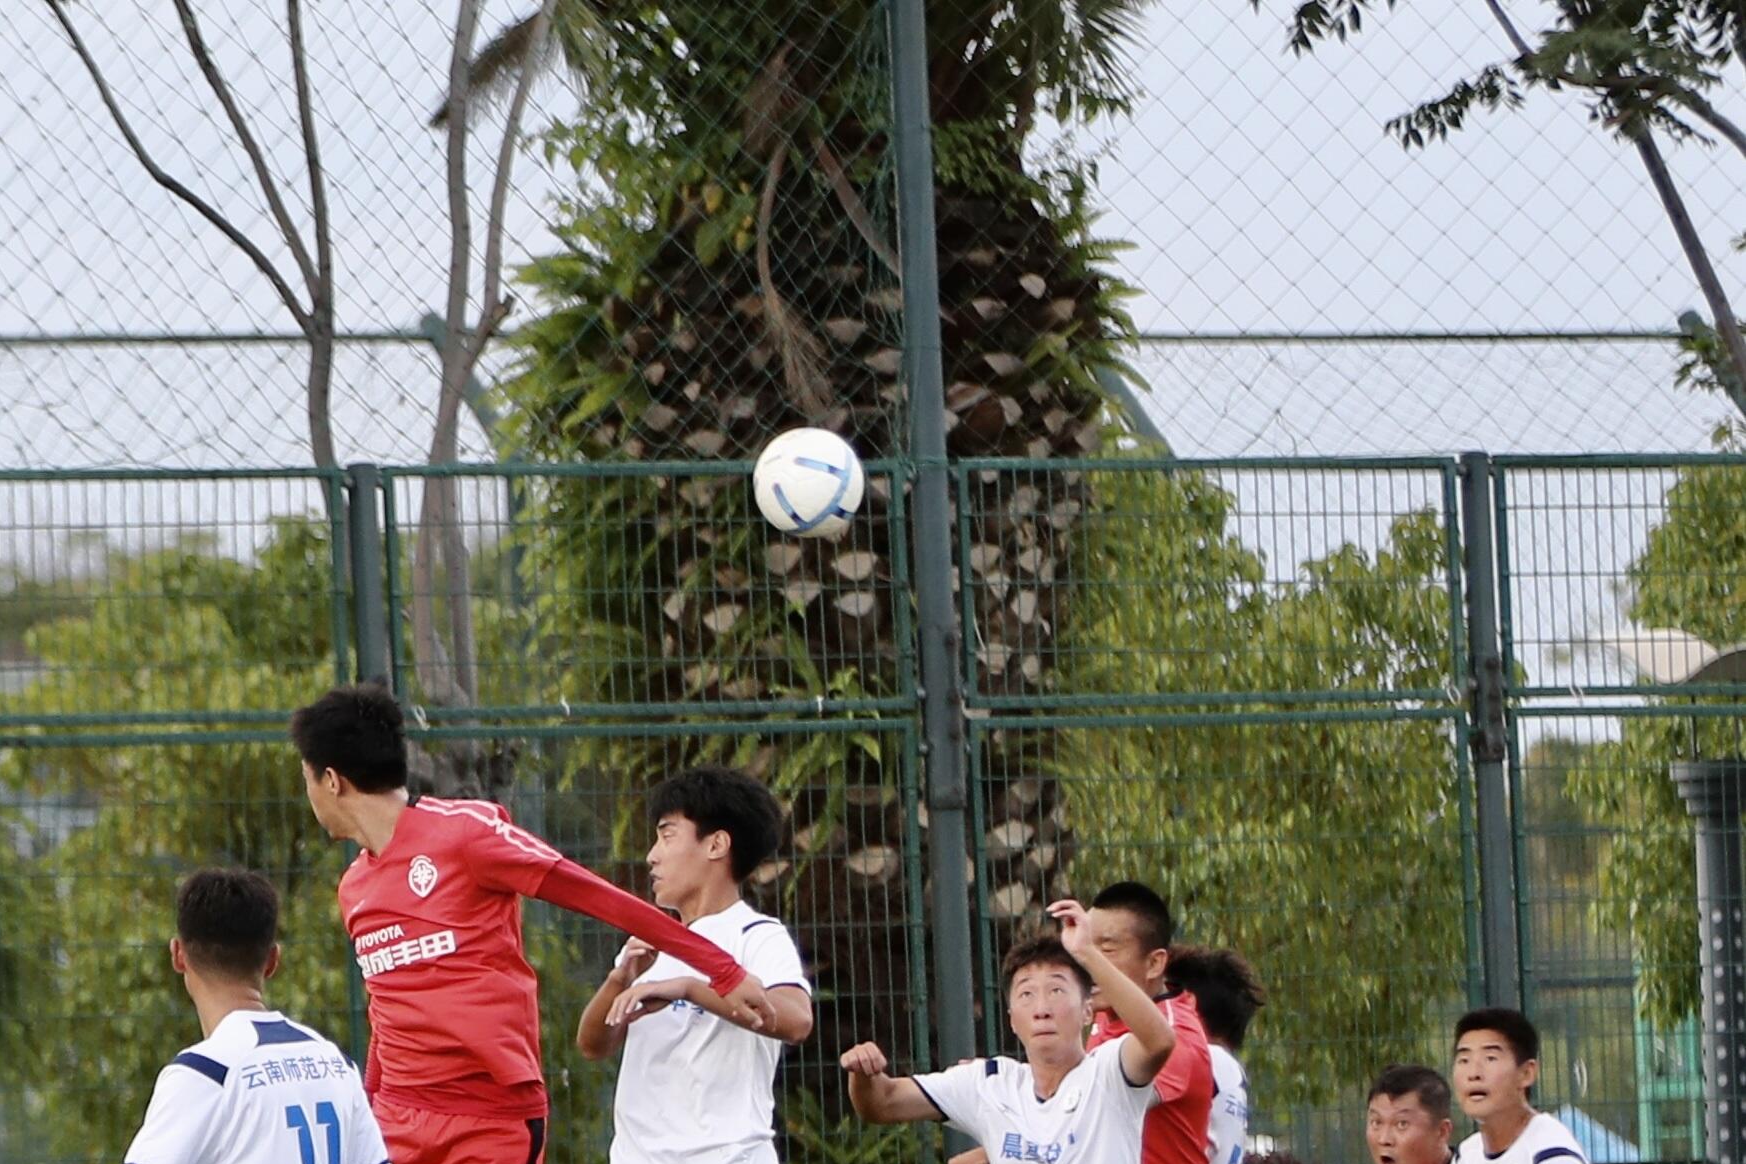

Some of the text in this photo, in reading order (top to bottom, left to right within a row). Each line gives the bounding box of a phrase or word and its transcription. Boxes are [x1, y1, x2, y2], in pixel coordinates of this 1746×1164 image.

[360, 923, 405, 951] TOYOTA
[240, 1054, 349, 1090] 云南师范大学
